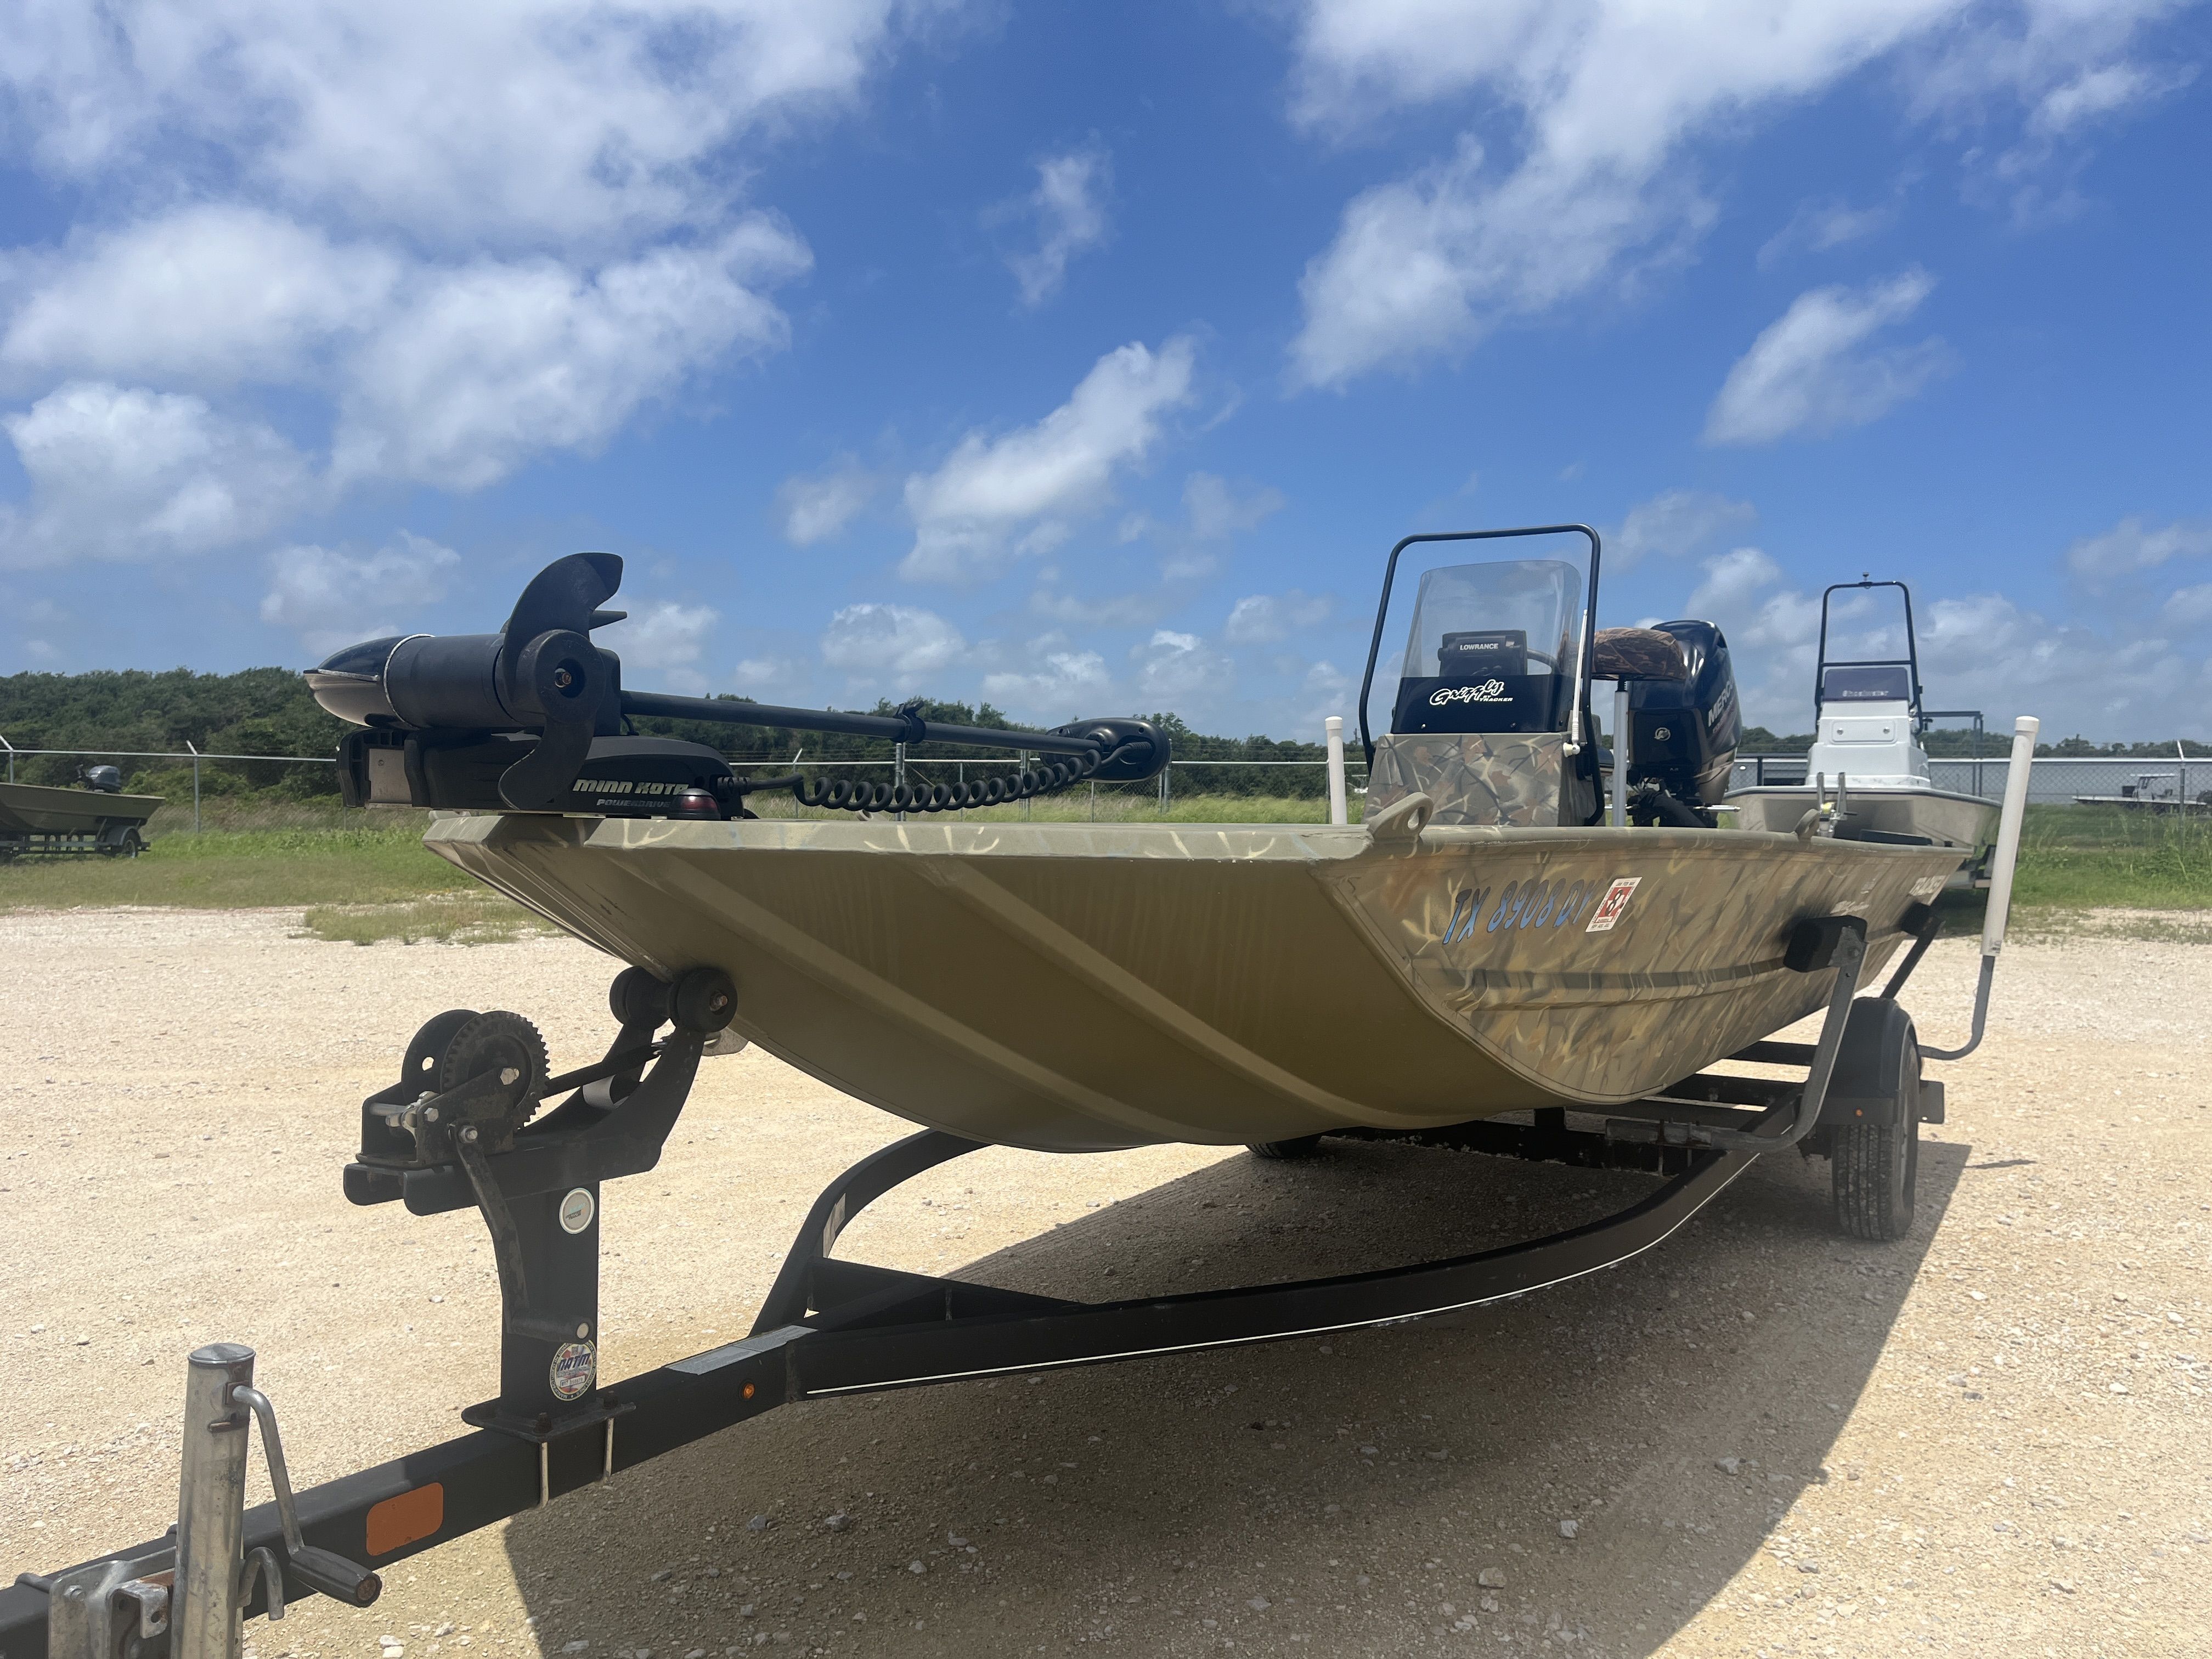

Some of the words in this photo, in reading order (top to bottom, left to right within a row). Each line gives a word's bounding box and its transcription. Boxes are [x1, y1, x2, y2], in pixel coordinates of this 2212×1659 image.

[1429, 679, 1504, 706] Grizzly
[573, 779, 633, 793] MINN
[1442, 887, 1491, 945] TX
[1487, 878, 1566, 933] 8908
[556, 1353, 591, 1372] NATM
